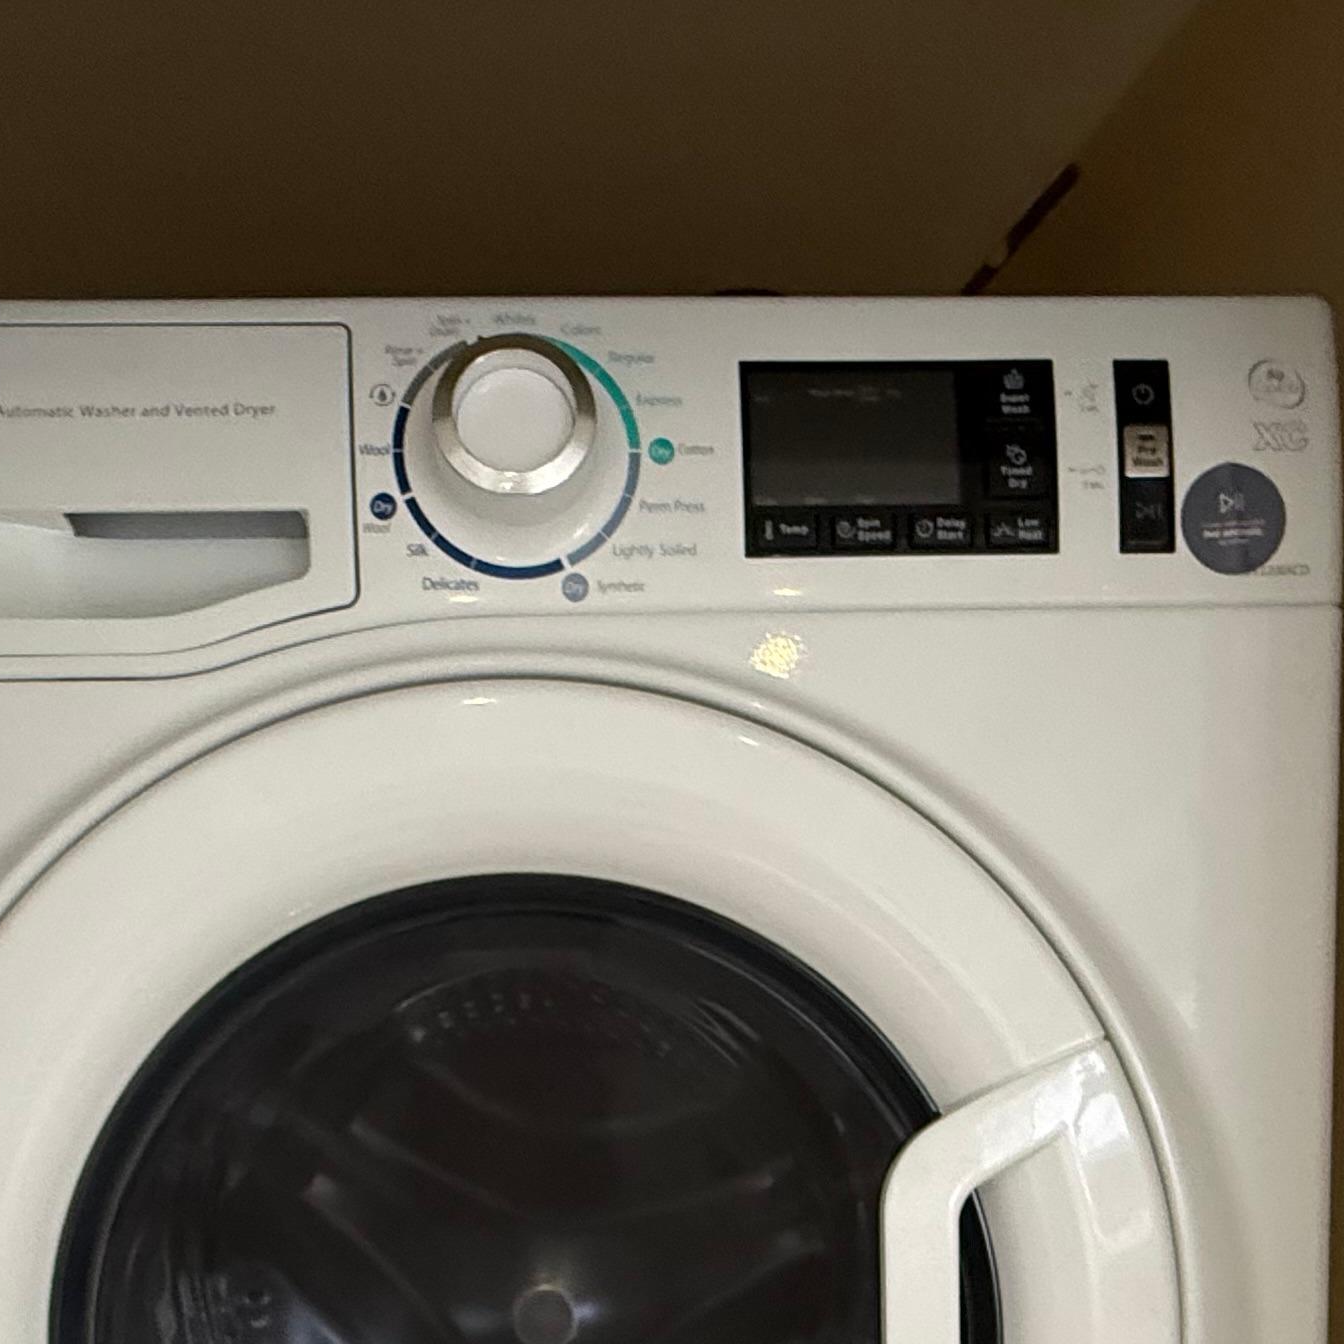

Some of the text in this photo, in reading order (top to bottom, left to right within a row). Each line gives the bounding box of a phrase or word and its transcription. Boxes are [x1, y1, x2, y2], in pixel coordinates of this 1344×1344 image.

[78, 403, 136, 418] Washer
[141, 403, 170, 418] and
[173, 402, 229, 417] Vented
[233, 401, 277, 420] Dryer
[612, 542, 698, 560] Lightly Soiled
[421, 576, 480, 592] Delicates
